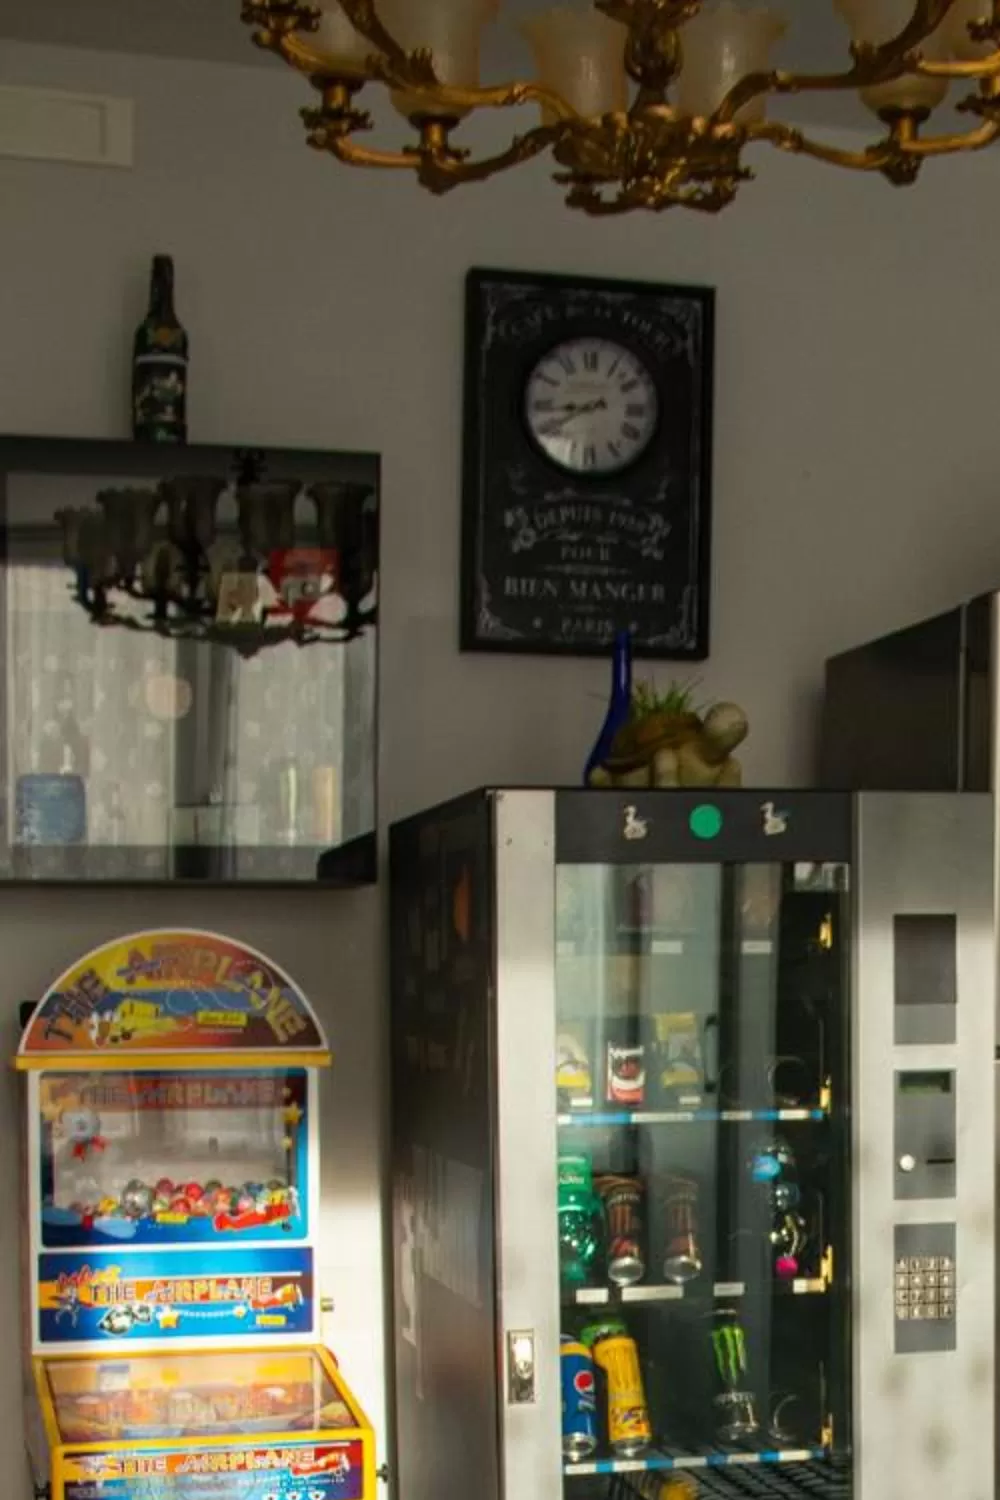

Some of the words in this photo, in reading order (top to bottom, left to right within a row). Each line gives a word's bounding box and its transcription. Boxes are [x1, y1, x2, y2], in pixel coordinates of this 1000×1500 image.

[504, 575, 557, 597] BIEN
[569, 578, 665, 604] MANGER
[89, 1281, 136, 1304] THE
[144, 1275, 272, 1304] AIRPLANE
